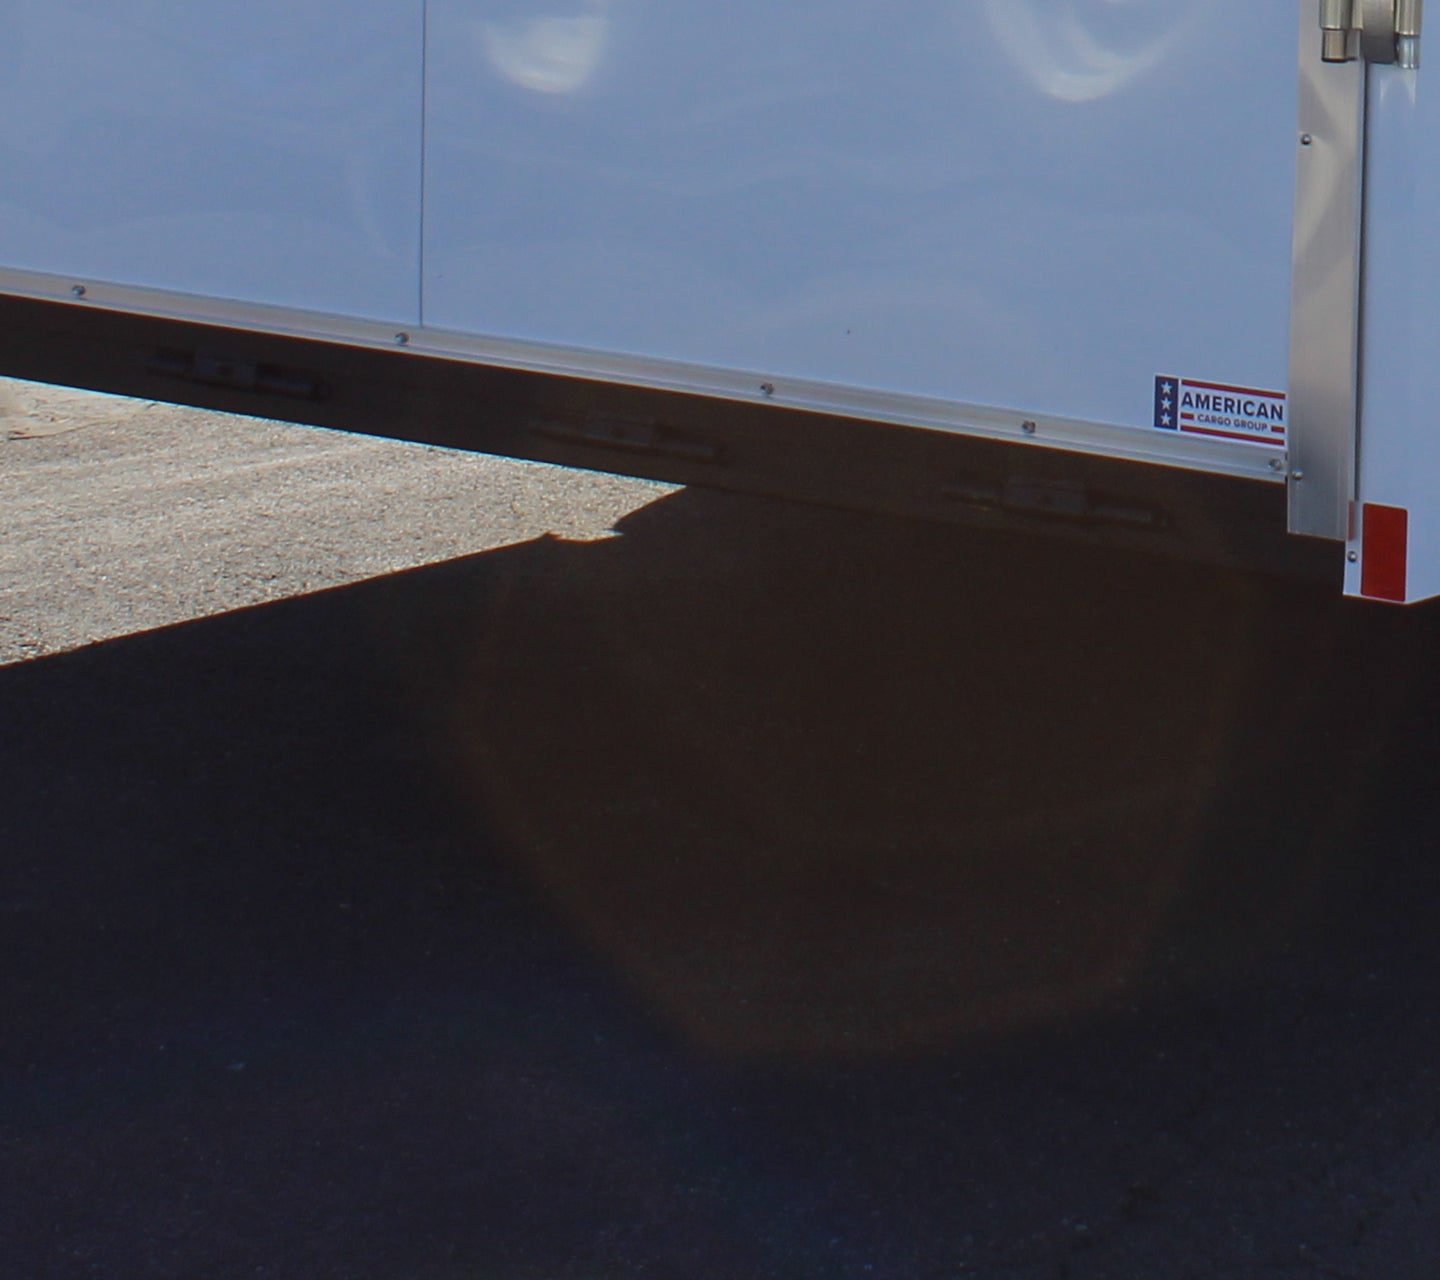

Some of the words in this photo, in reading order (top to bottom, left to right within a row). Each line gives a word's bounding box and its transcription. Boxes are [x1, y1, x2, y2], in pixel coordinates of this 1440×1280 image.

[1181, 392, 1283, 421] AMERICAN
[1197, 414, 1231, 426] CARGO
[1233, 420, 1268, 431] GROUP
